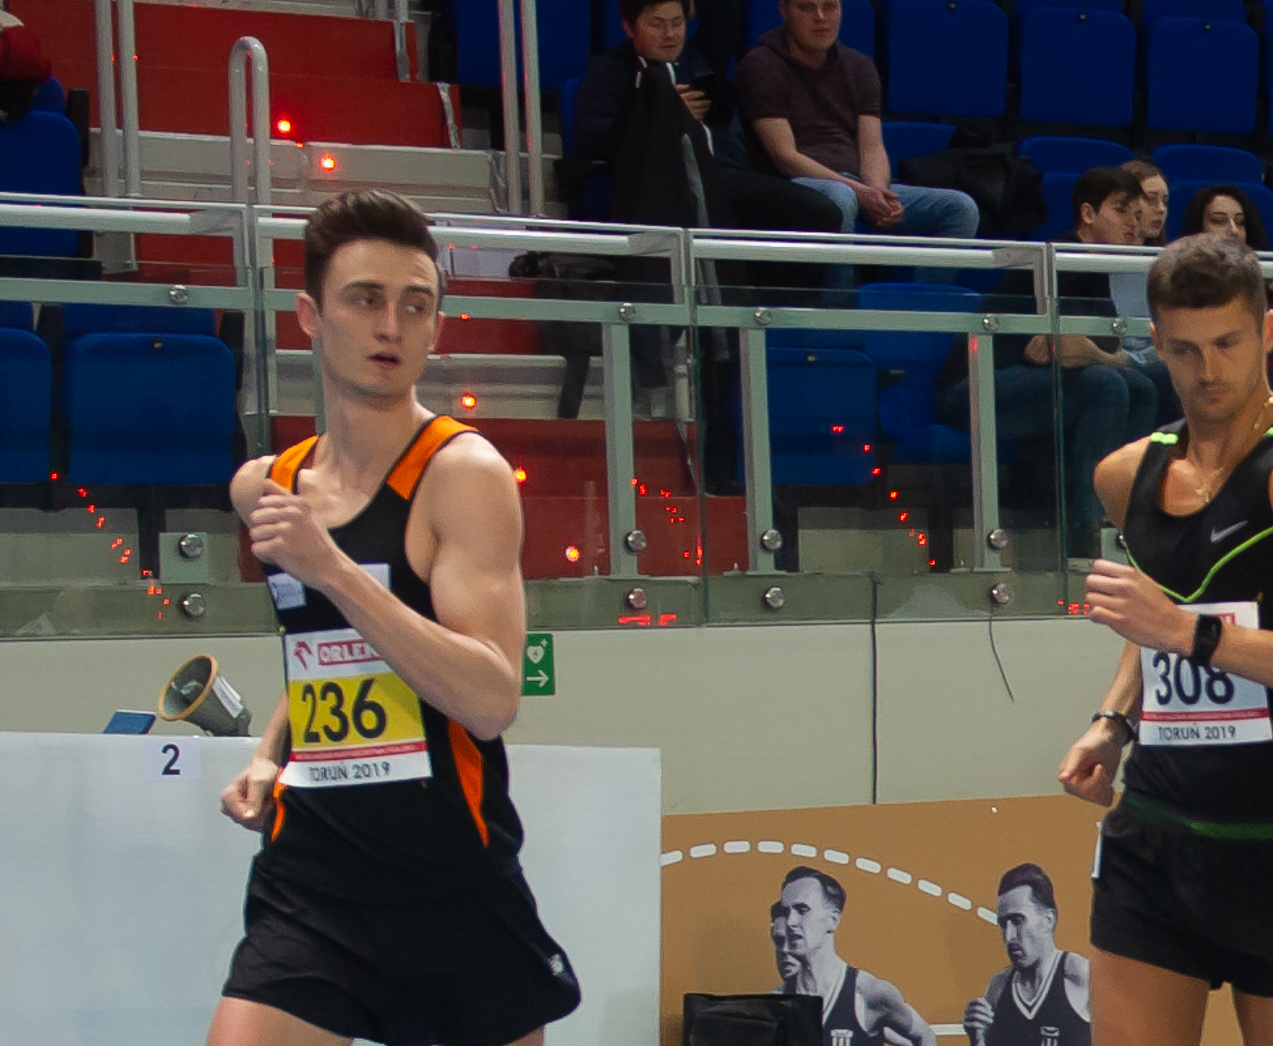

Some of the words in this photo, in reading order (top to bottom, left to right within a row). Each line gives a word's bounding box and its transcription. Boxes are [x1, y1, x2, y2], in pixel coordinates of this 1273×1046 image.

[1152, 651, 1235, 705] 308
[301, 677, 387, 743] 236
[1204, 725, 1236, 740] 2019
[161, 744, 181, 776] 2
[353, 761, 391, 780] 2019
